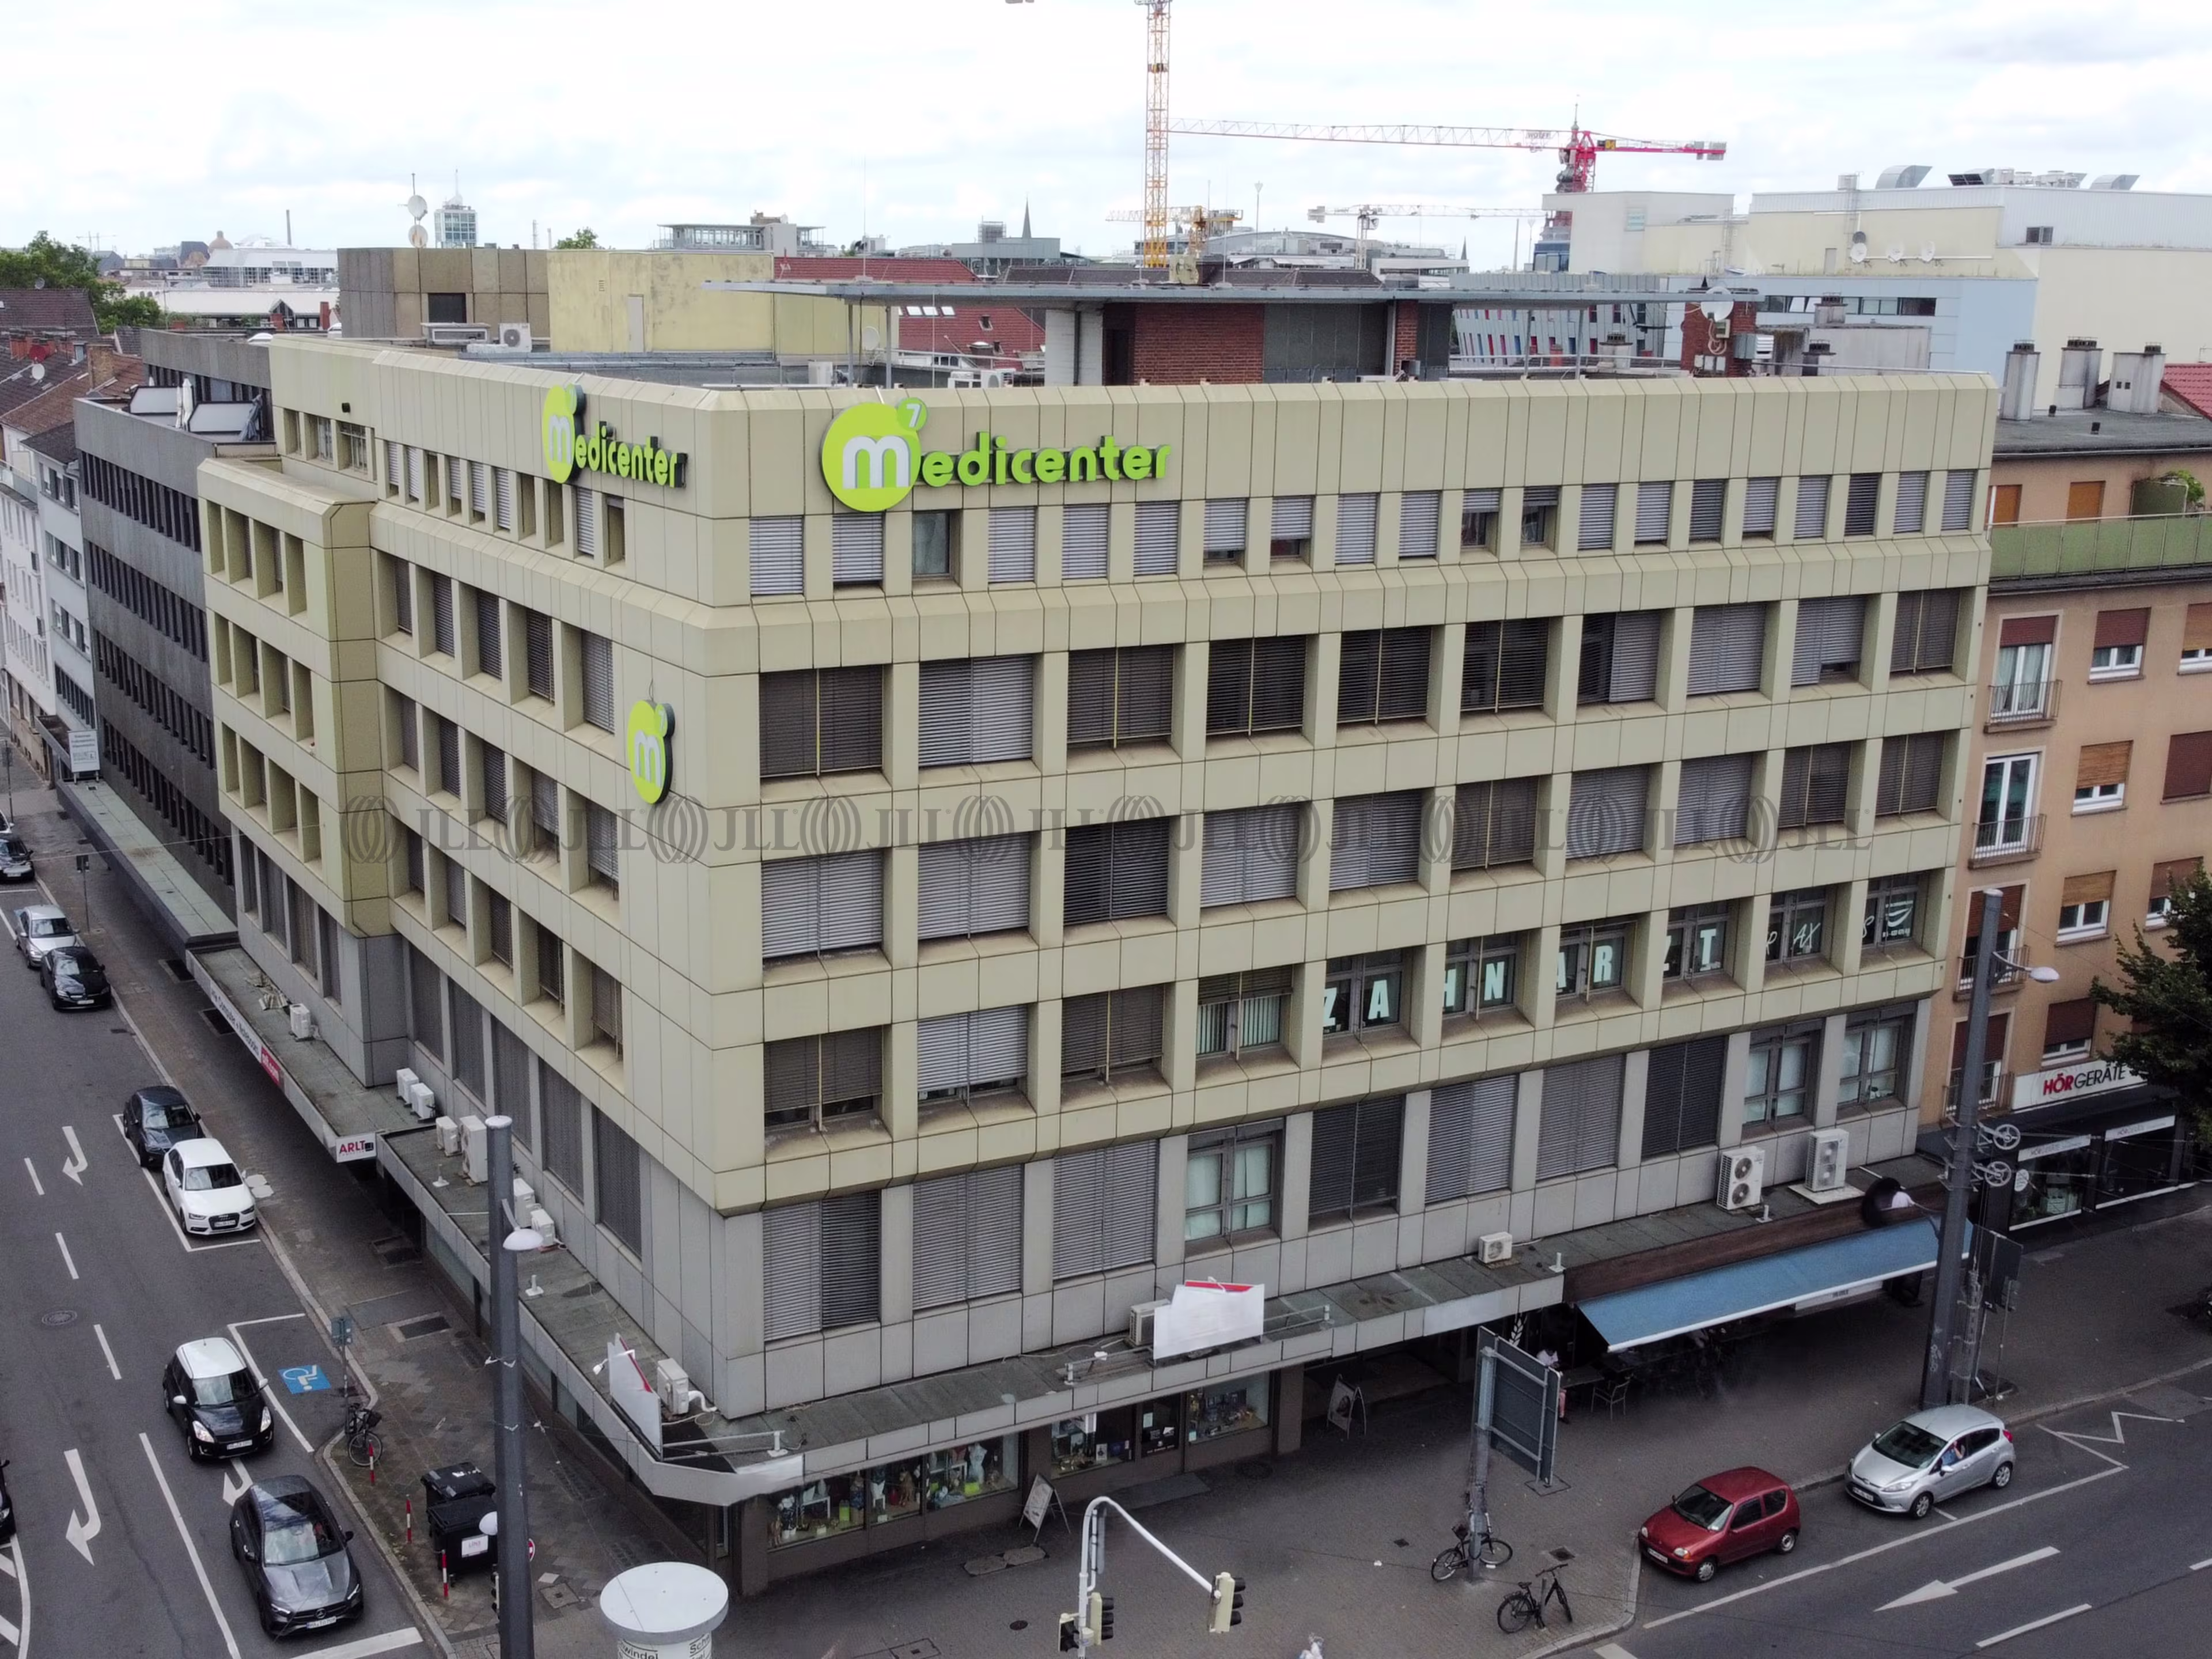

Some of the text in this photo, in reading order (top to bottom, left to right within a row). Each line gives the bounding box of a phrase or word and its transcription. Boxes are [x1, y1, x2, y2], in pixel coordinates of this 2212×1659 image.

[906, 404, 922, 428] 7
[2043, 1063, 2126, 1096] HÖRGERÄTE
[339, 1140, 366, 1154] ARLT
